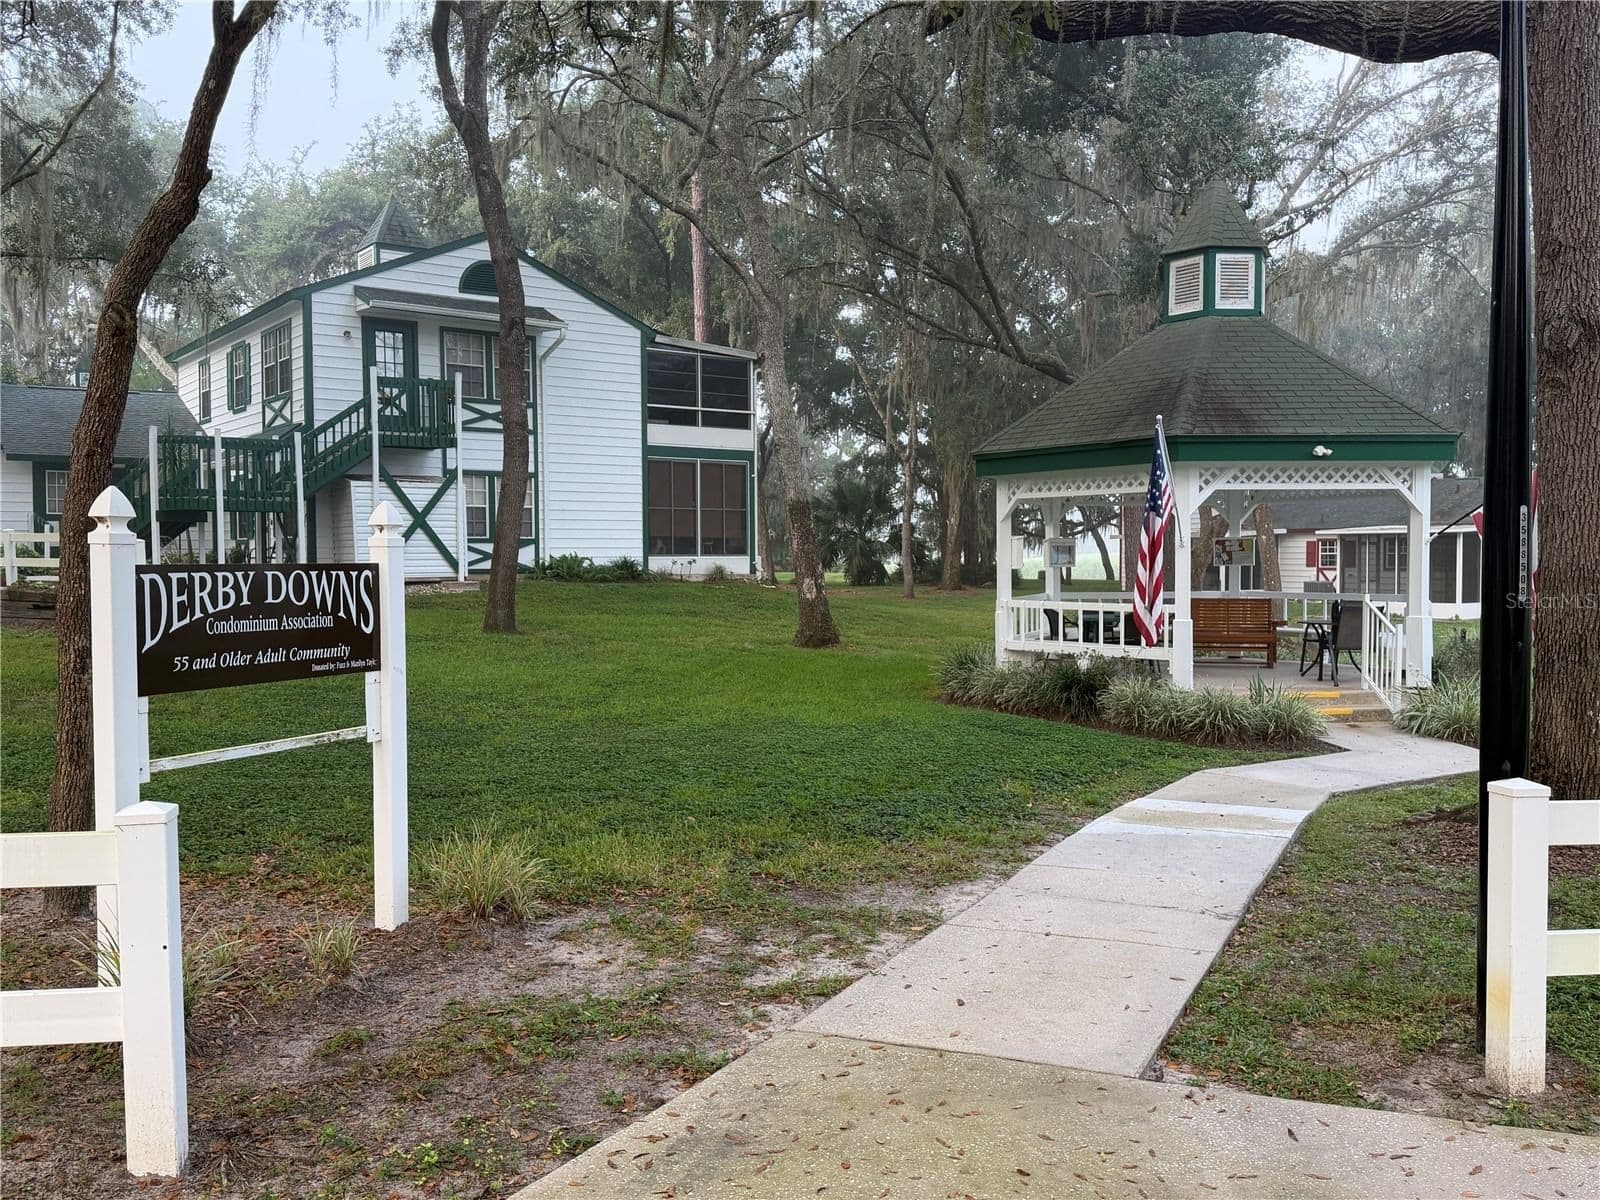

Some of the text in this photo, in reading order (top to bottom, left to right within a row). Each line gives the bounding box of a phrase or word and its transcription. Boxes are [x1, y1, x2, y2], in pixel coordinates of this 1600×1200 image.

[140, 569, 374, 654] DERBY DOWNS
[206, 611, 334, 635] Condominium Association
[173, 642, 351, 672] 55 and Older Adult Community
[311, 662, 330, 672] Donated
